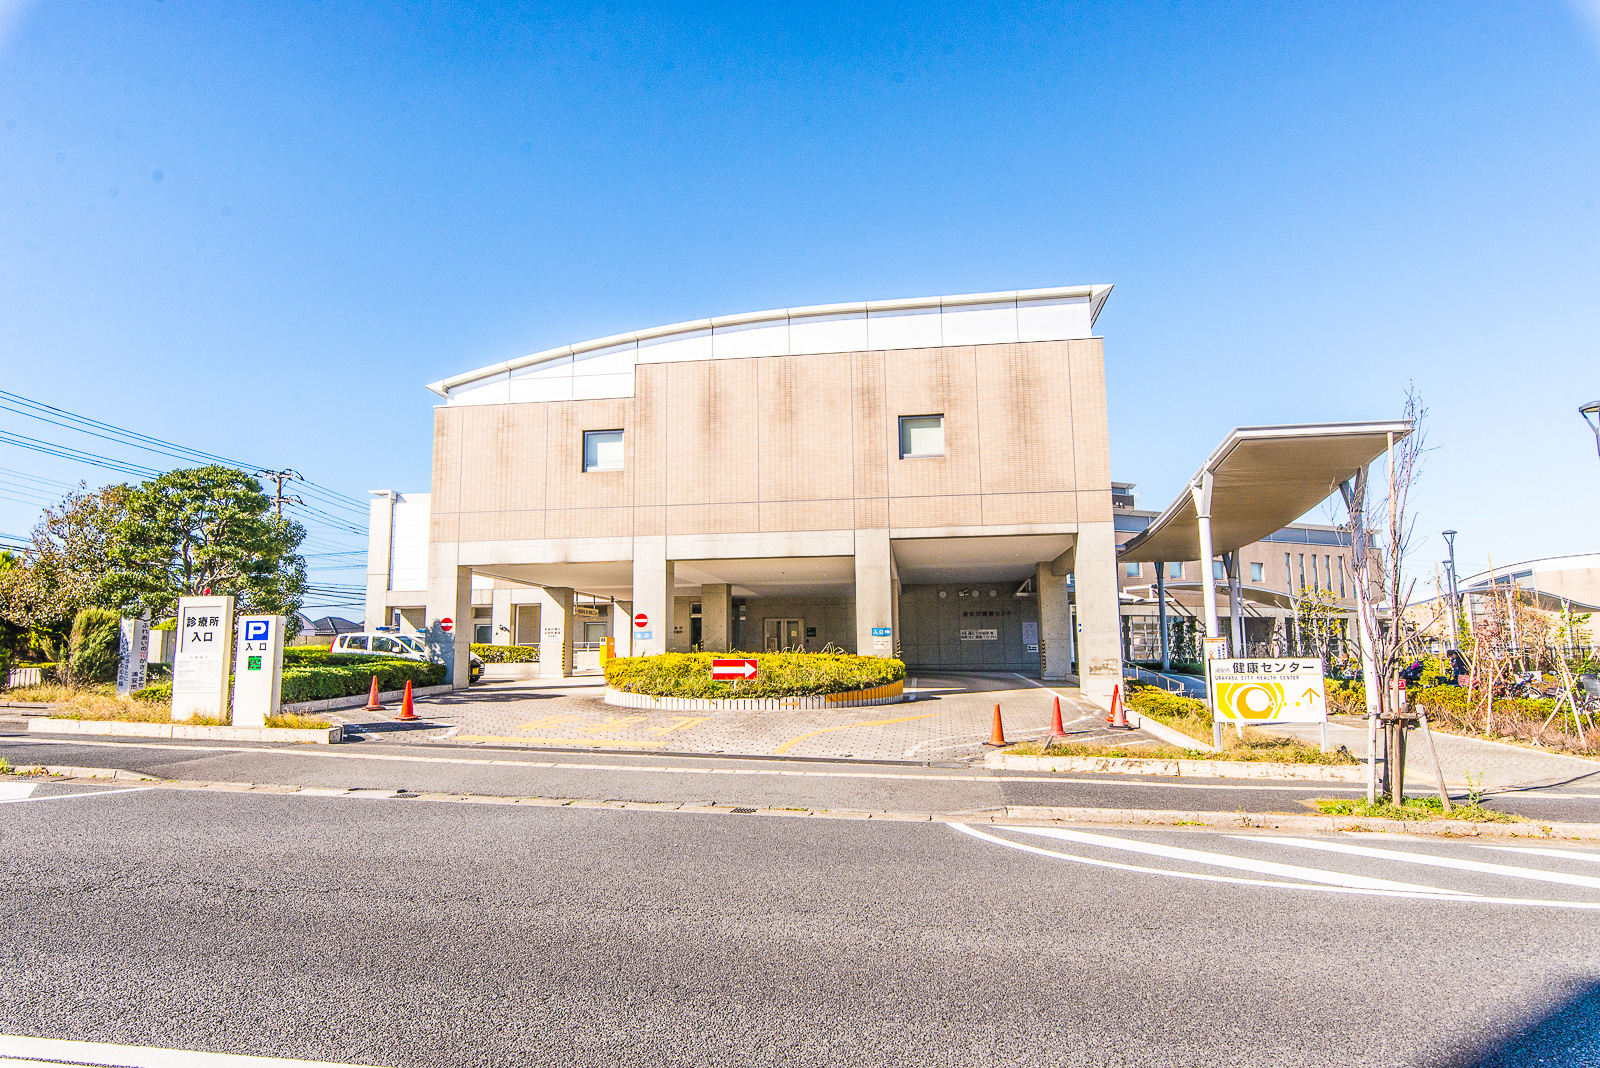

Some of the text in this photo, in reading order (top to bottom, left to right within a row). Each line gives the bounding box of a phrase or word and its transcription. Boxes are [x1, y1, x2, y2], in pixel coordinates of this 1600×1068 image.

[186, 616, 219, 628] 診療所
[191, 631, 213, 643] 入口
[247, 622, 267, 640] P
[245, 642, 267, 651] 入口
[248, 656, 261, 670] 空
[1232, 661, 1314, 674] 健康センター
